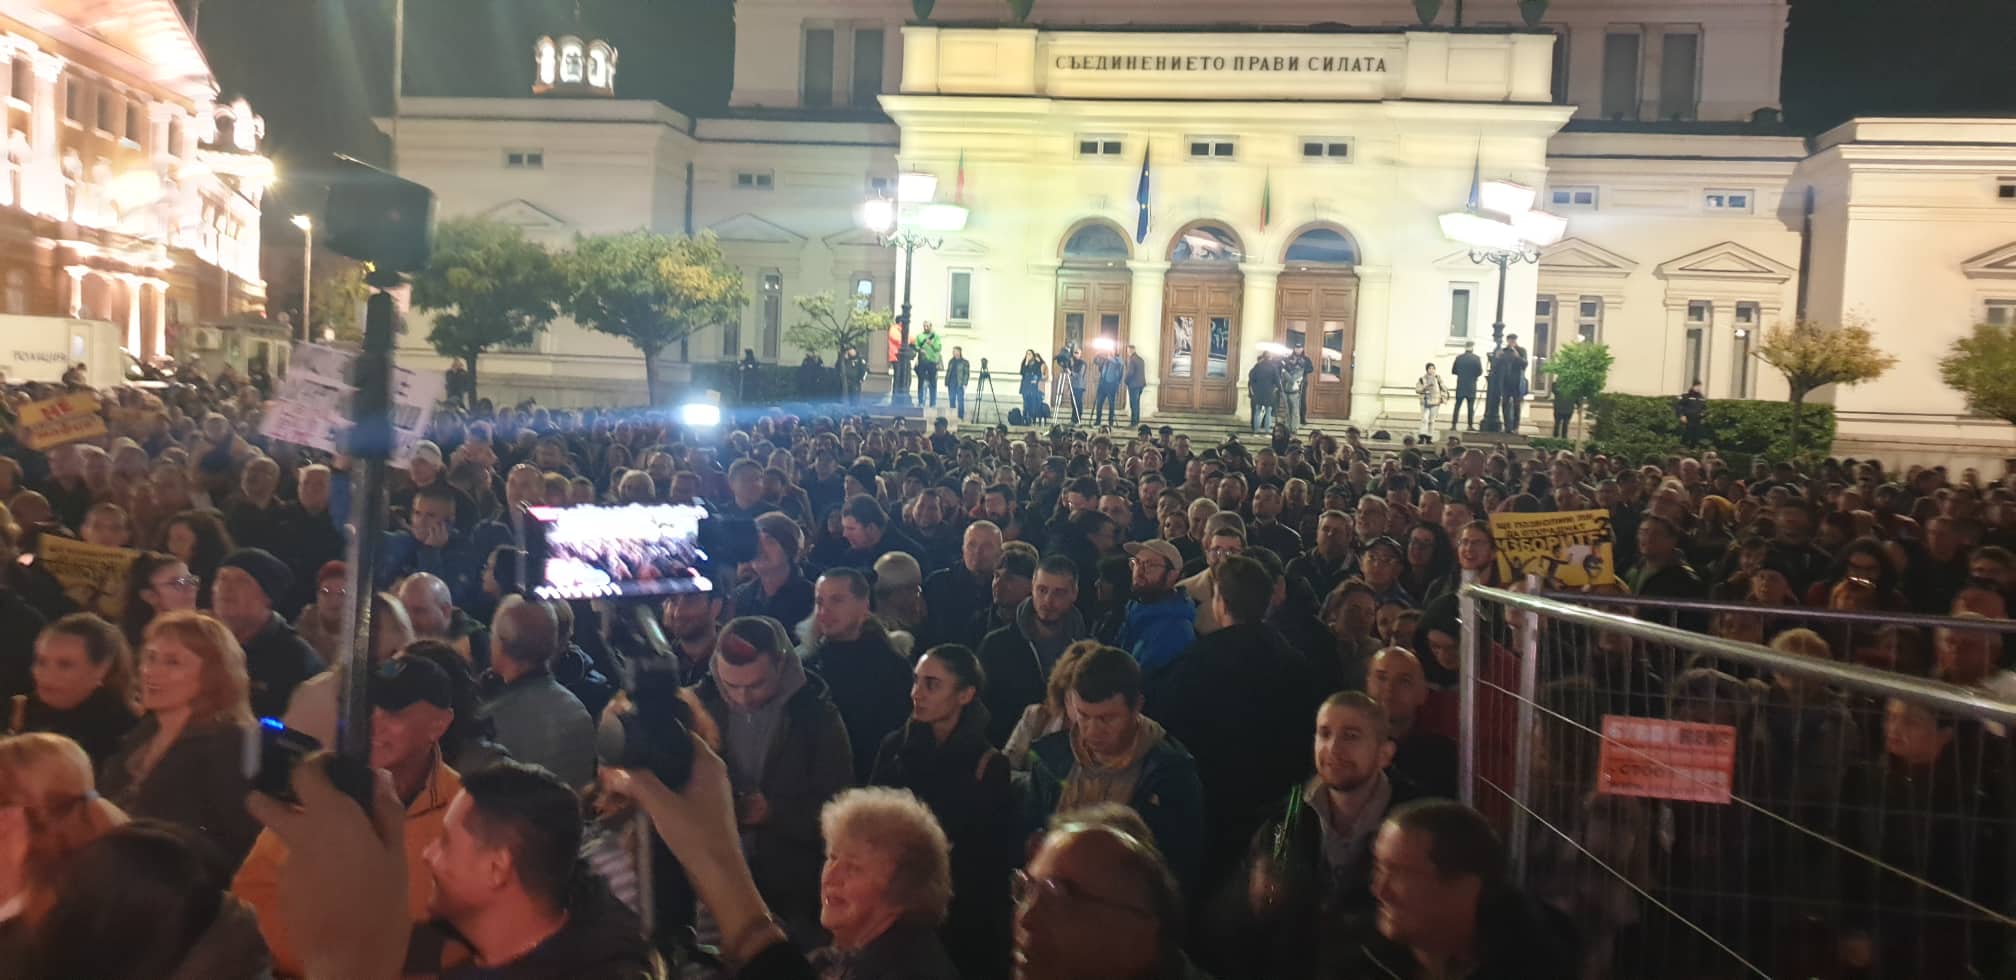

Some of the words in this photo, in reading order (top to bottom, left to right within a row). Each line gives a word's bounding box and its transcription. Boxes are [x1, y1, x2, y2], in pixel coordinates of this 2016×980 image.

[1055, 55, 1225, 71] СЪЕДИНЕНИЕТО
[1233, 55, 1299, 71] ПРАВИ
[1307, 56, 1387, 72] СИЛАТА
